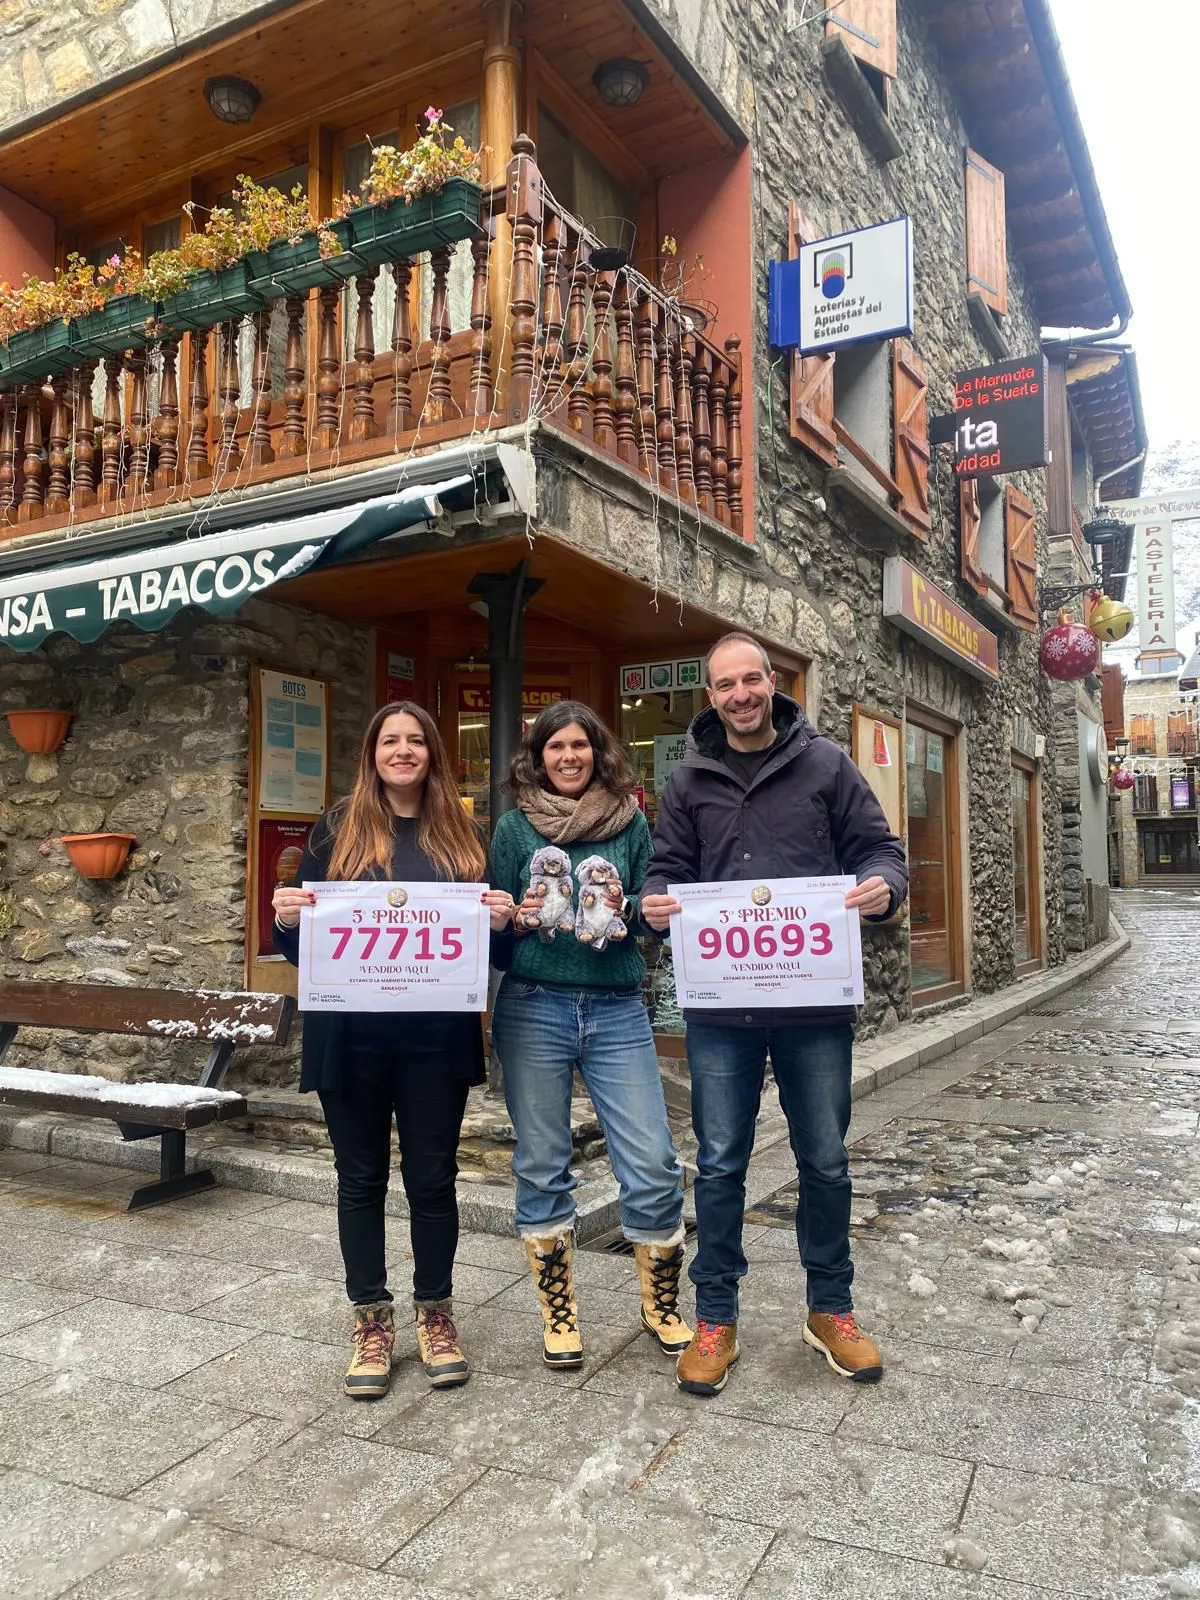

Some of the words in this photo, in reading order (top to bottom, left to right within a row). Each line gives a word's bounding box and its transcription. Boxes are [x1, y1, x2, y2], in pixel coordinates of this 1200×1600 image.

[814, 297, 856, 314] Loterías
[859, 295, 866, 306] y
[814, 307, 863, 327] Apuestas
[866, 301, 882, 314] del
[814, 323, 850, 339] Estado
[955, 382, 972, 394] La
[975, 367, 1035, 389] Marmota
[955, 396, 973, 409] De
[978, 392, 990, 404] la
[955, 416, 999, 453] ta
[98, 549, 275, 620] TABACOS
[1145, 526, 1167, 645] PASTELERIA
[929, 596, 979, 655] TABACOS
[282, 680, 306, 697] BOTES
[521, 691, 562, 705] ACOS
[372, 909, 441, 924] PREMIO
[738, 906, 807, 923] PREMIO
[329, 927, 463, 961] 77715
[698, 922, 833, 960] 90693
[360, 965, 402, 974] VENDIDO
[731, 963, 774, 972] VENDIDO
